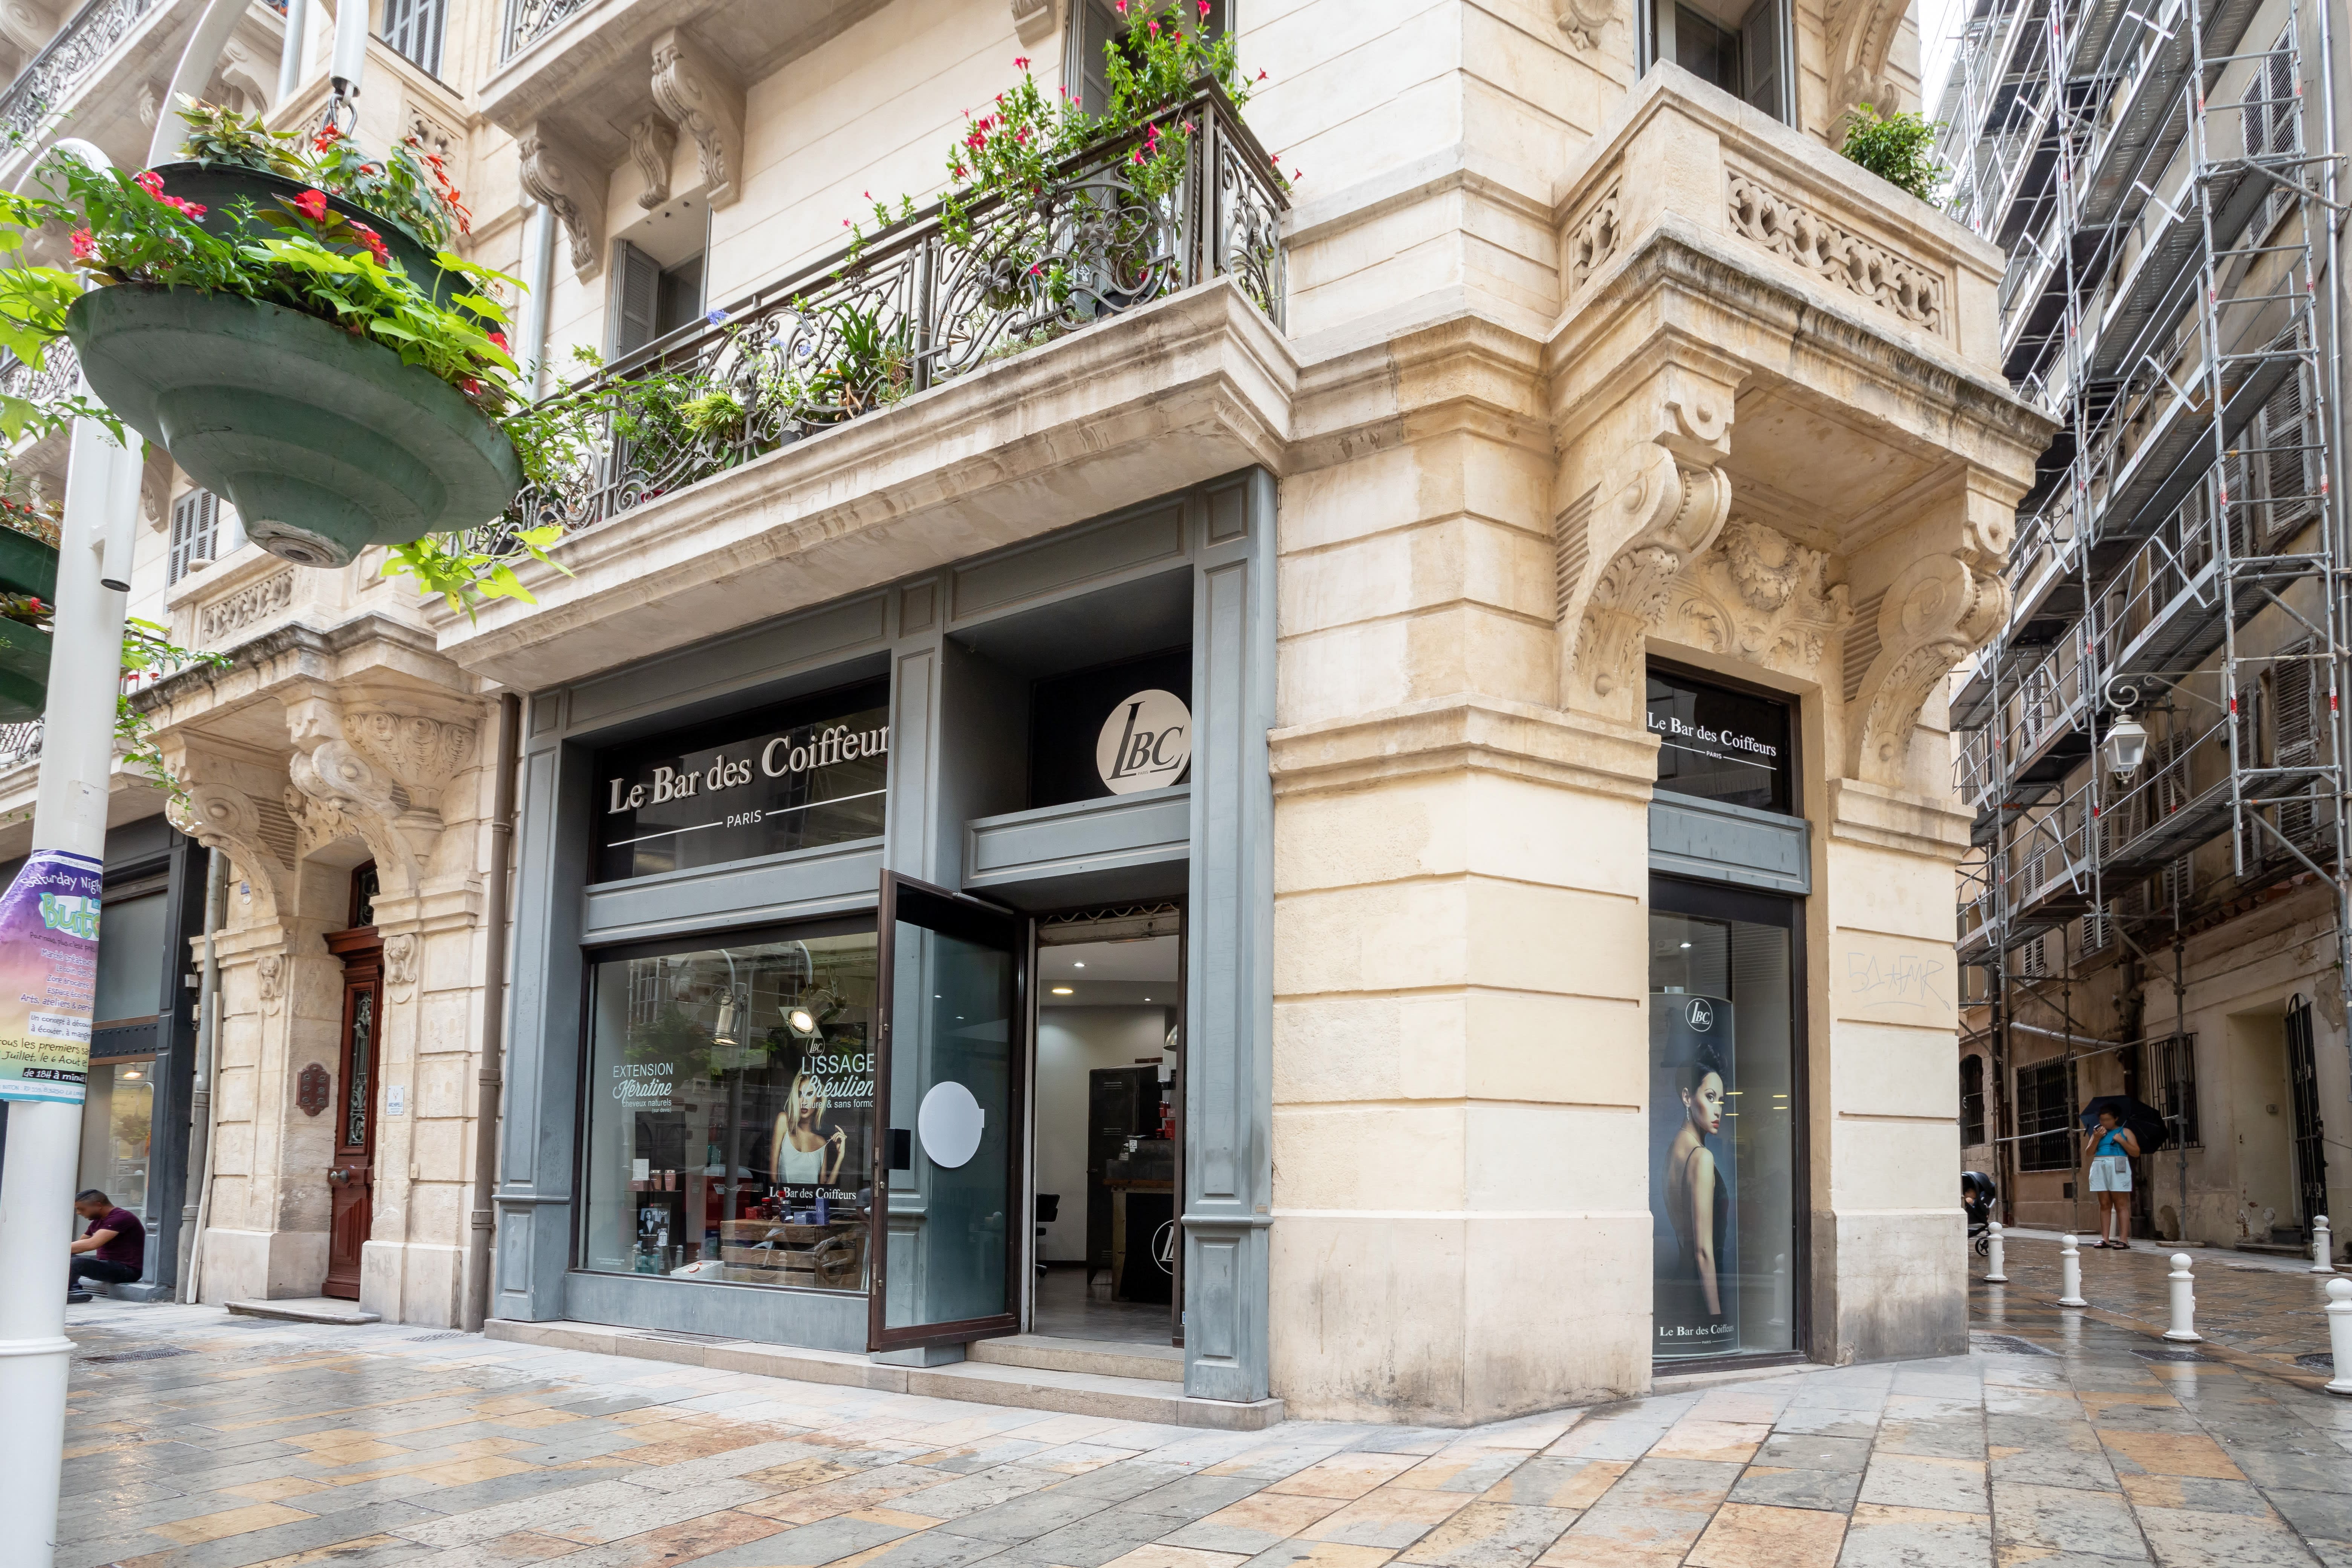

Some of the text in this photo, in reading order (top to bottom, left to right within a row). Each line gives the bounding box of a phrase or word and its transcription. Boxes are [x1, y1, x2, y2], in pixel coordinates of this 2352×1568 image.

[1106, 701, 1185, 780] LBC
[1647, 712, 1776, 756] Le Bar des Coiffeurs
[1706, 750, 1722, 759] PARIS
[608, 778, 645, 814] Le
[651, 766, 702, 804] Bar
[707, 755, 753, 791] des
[727, 810, 762, 828] PARIS
[20, 871, 77, 891] Saturday
[47, 974, 62, 983] Zone
[47, 987, 69, 997] Espace
[20, 994, 40, 1004] Arts,
[42, 998, 70, 1009] ateliers
[1690, 1002, 1710, 1024] LBC
[41, 1017, 65, 1026] concept
[31, 1024, 35, 1032] à
[38, 1025, 64, 1036] écouter,
[21, 1038, 35, 1049] les
[38, 1043, 80, 1054] premiers
[1, 1050, 36, 1062] Juillet,
[40, 1052, 49, 1062] le
[58, 1055, 81, 1066] Aout
[802, 1053, 874, 1074] LISSAGE
[23, 1069, 34, 1078] de
[36, 1070, 52, 1079] 18H
[53, 1070, 60, 1080] à
[613, 1062, 673, 1078] EXTENSION
[612, 1078, 672, 1104] Kératine
[801, 1075, 874, 1100] Brésilien
[622, 1098, 672, 1107] cheveux naturels
[827, 1100, 832, 1108] &
[769, 1187, 856, 1200] Le Bar des Coiffeurs
[1659, 1324, 1734, 1336] Le Bar des Coiffeurs
